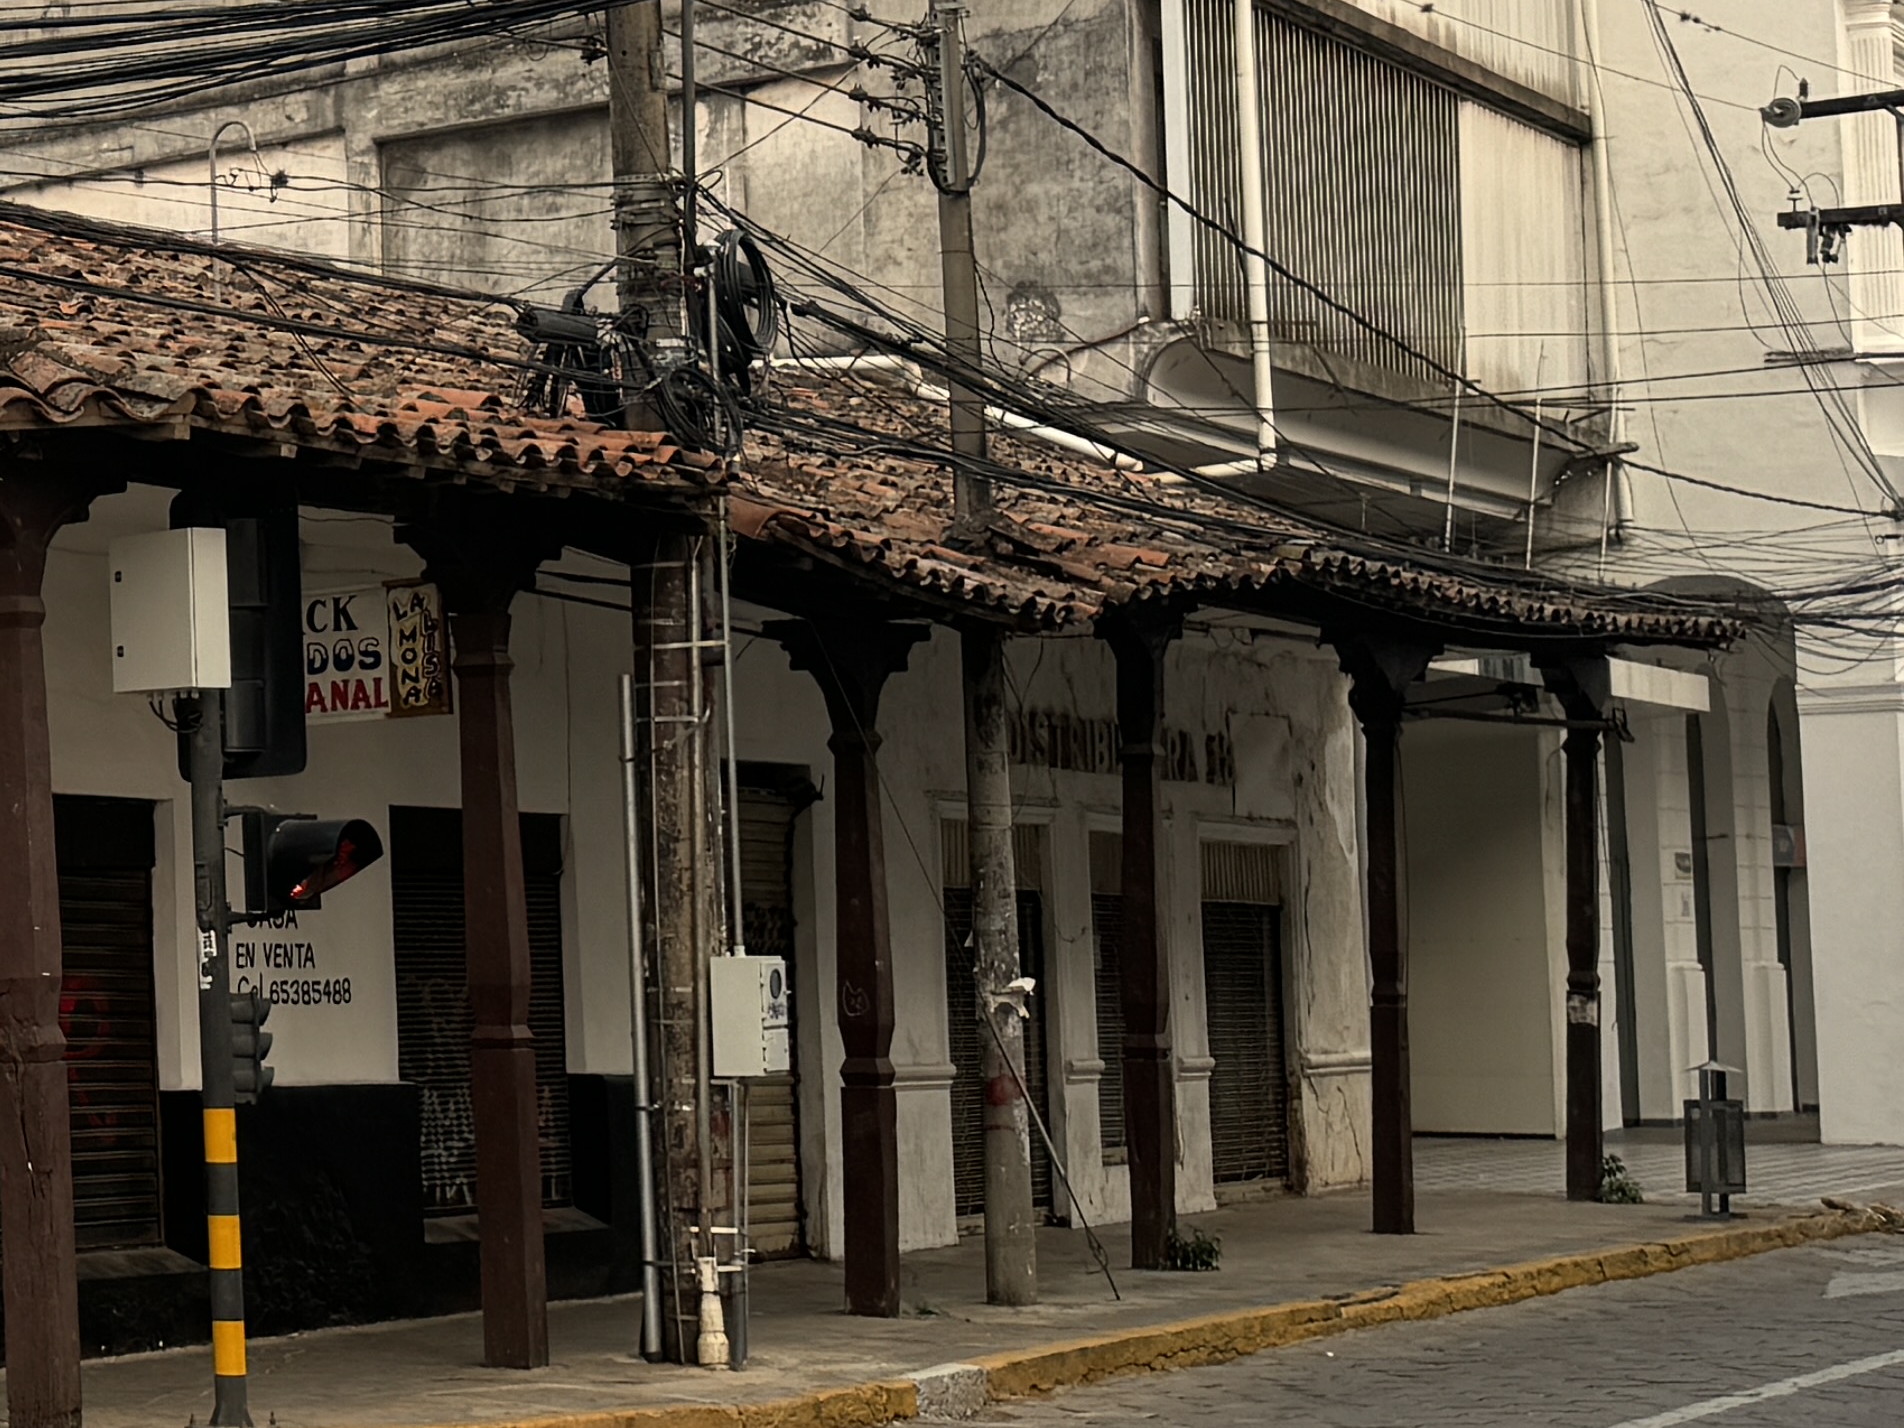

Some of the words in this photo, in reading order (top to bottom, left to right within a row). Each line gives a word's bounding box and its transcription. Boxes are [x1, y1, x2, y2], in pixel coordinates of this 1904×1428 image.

[393, 592, 426, 622] LA
[399, 624, 423, 706] MONA
[235, 942, 256, 969] EN
[262, 942, 316, 969] VENTA
[269, 977, 352, 1005] 65385488
